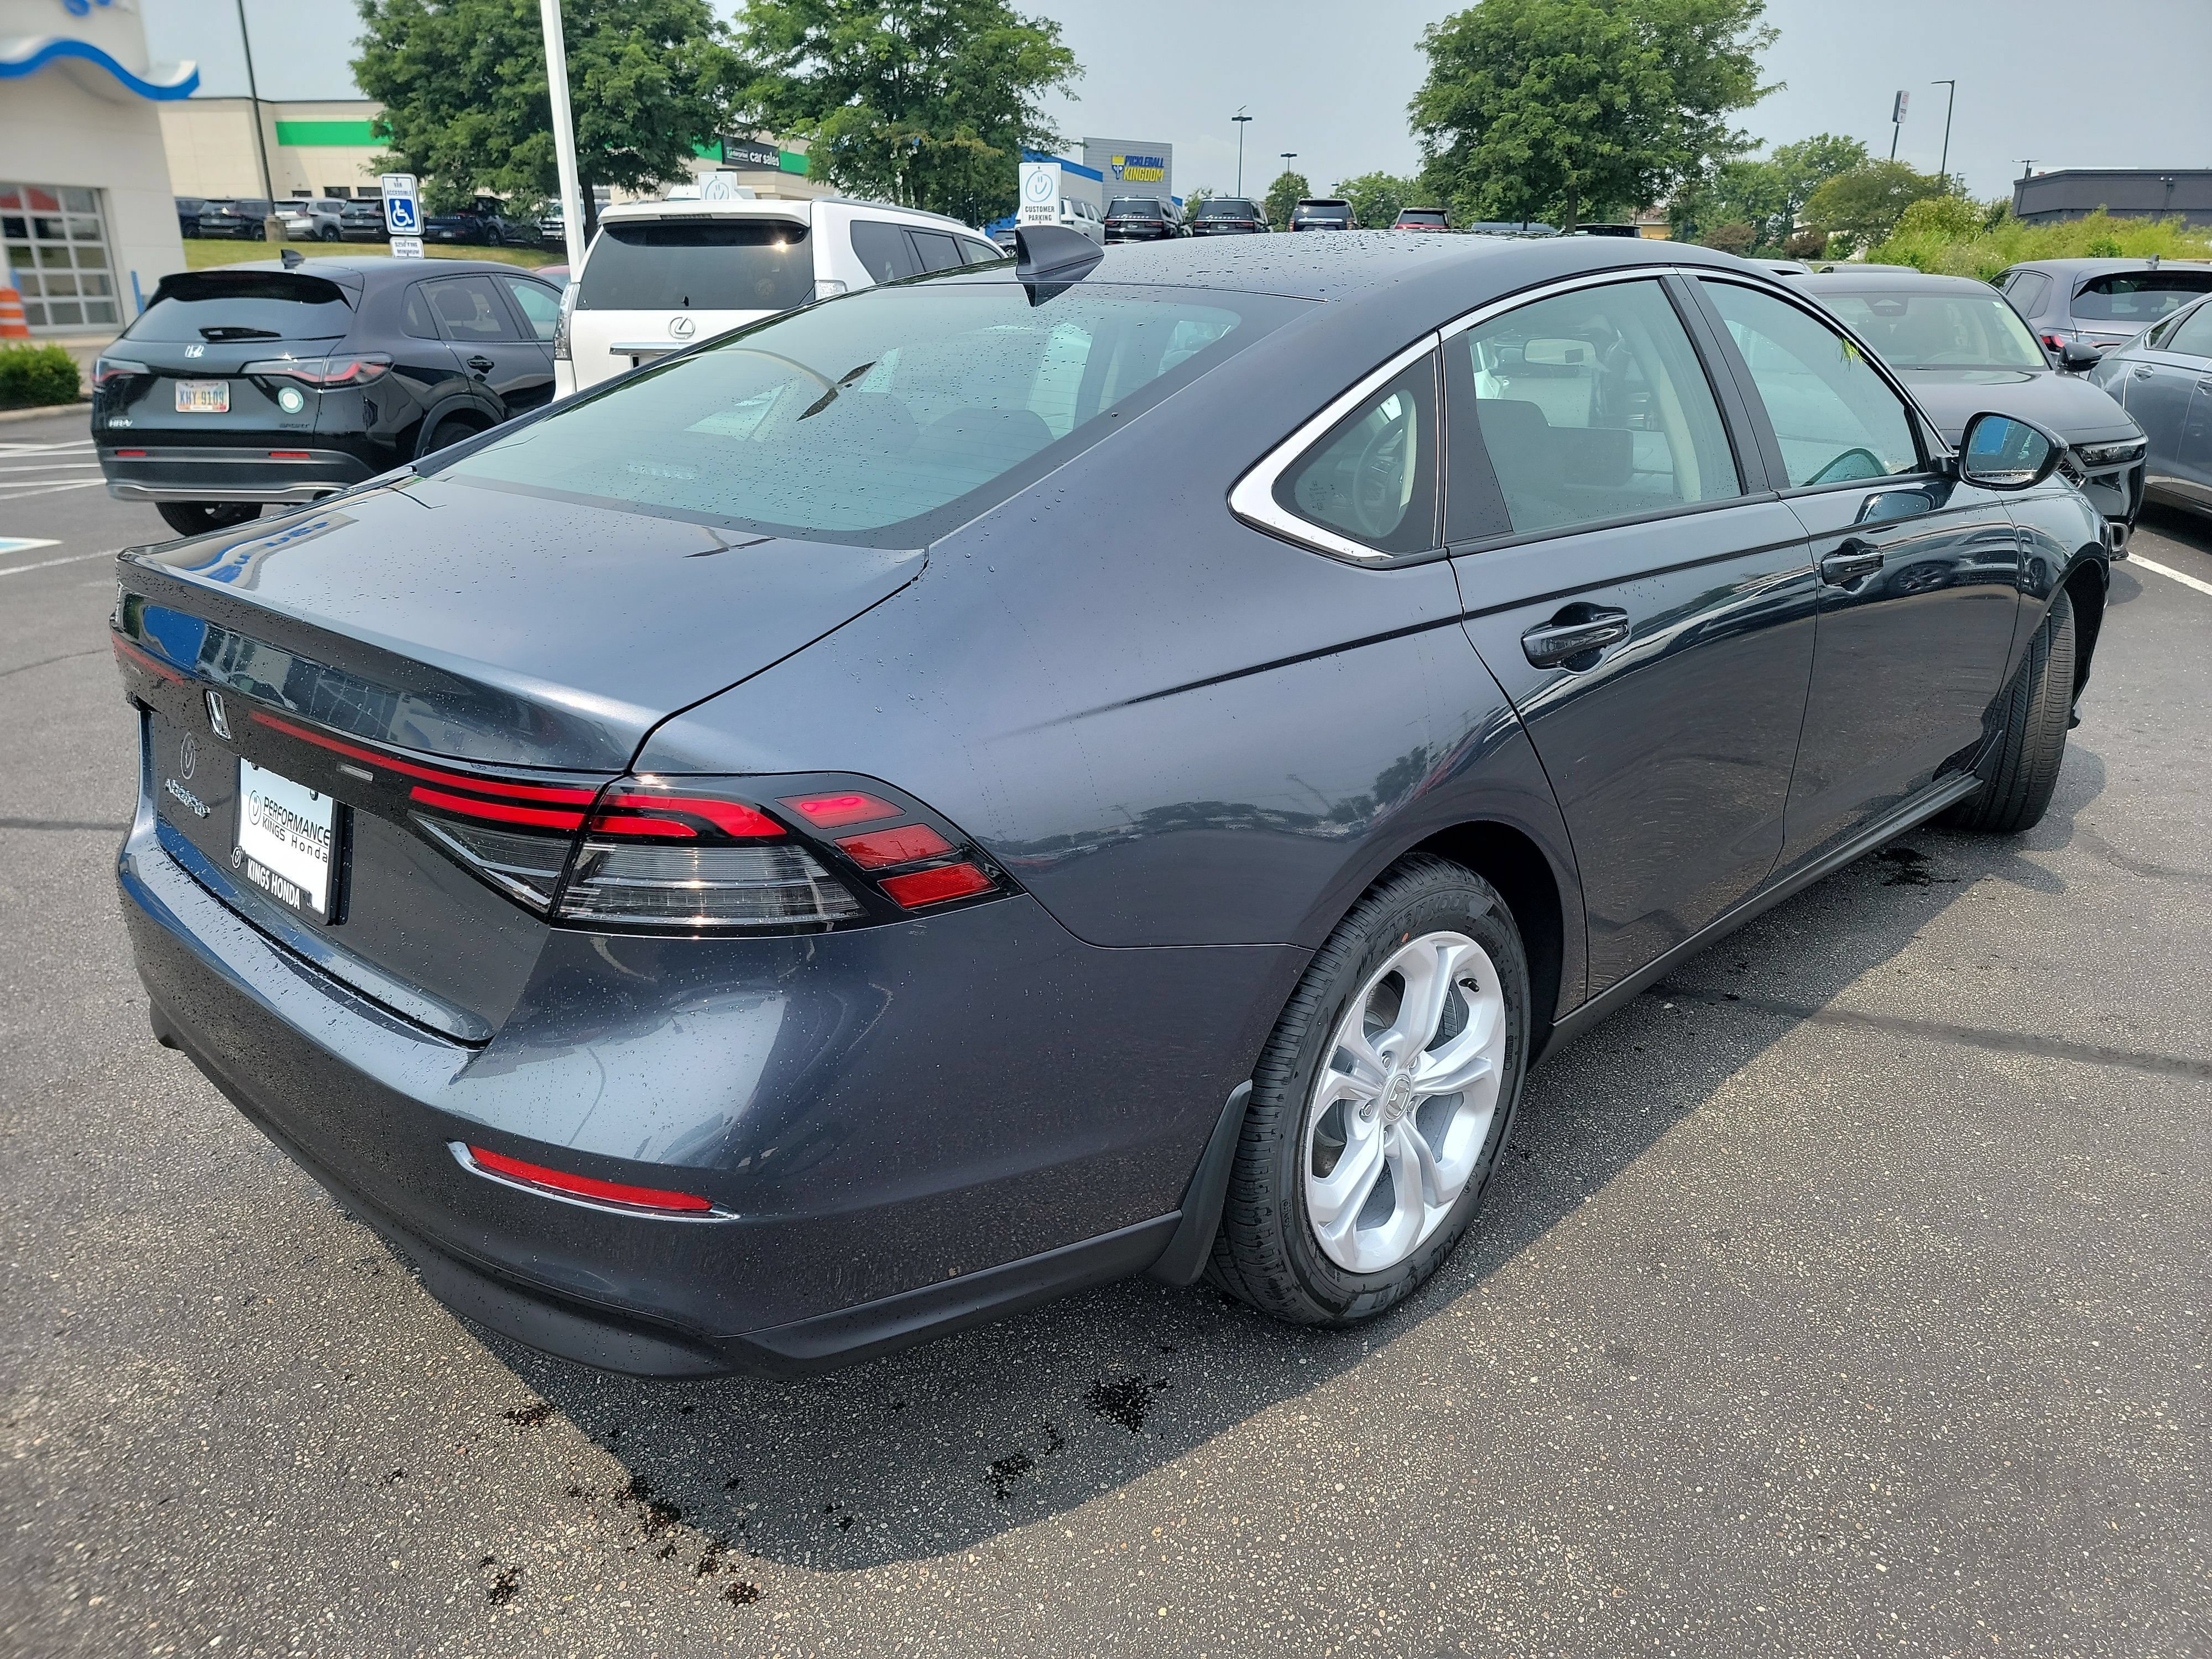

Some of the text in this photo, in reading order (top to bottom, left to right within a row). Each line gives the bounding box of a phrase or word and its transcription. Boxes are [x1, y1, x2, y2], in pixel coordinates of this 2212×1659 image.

[749, 152, 762, 163] car
[763, 151, 780, 166] sales
[1124, 155, 1164, 168] PICKLEBALL
[1123, 167, 1164, 182] KINGDOM
[264, 796, 331, 847] PERFORMANCE
[263, 816, 328, 863] KINGS Honda
[248, 858, 300, 910] KINGS HONDA
